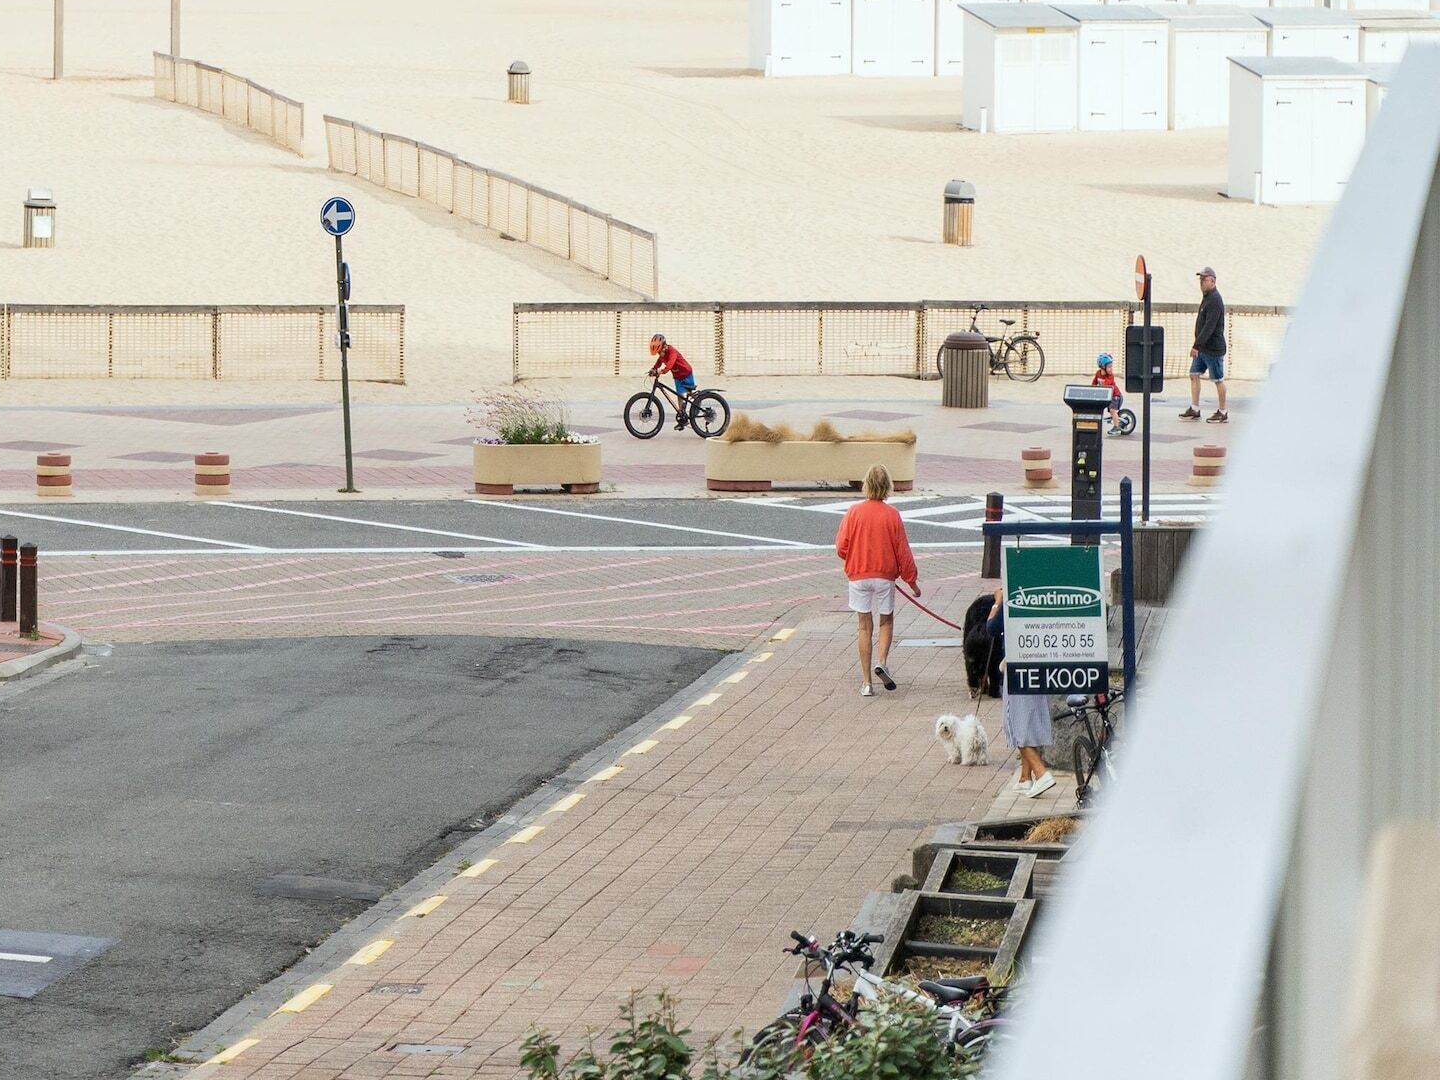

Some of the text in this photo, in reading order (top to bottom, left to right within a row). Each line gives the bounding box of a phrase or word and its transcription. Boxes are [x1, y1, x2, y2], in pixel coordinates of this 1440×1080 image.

[1015, 587, 1092, 606] avantimmo
[1023, 621, 1086, 630] www.avantimmo.be
[1018, 634, 1095, 648] 050 62 50 55
[1015, 668, 1100, 689] TE KOOP
